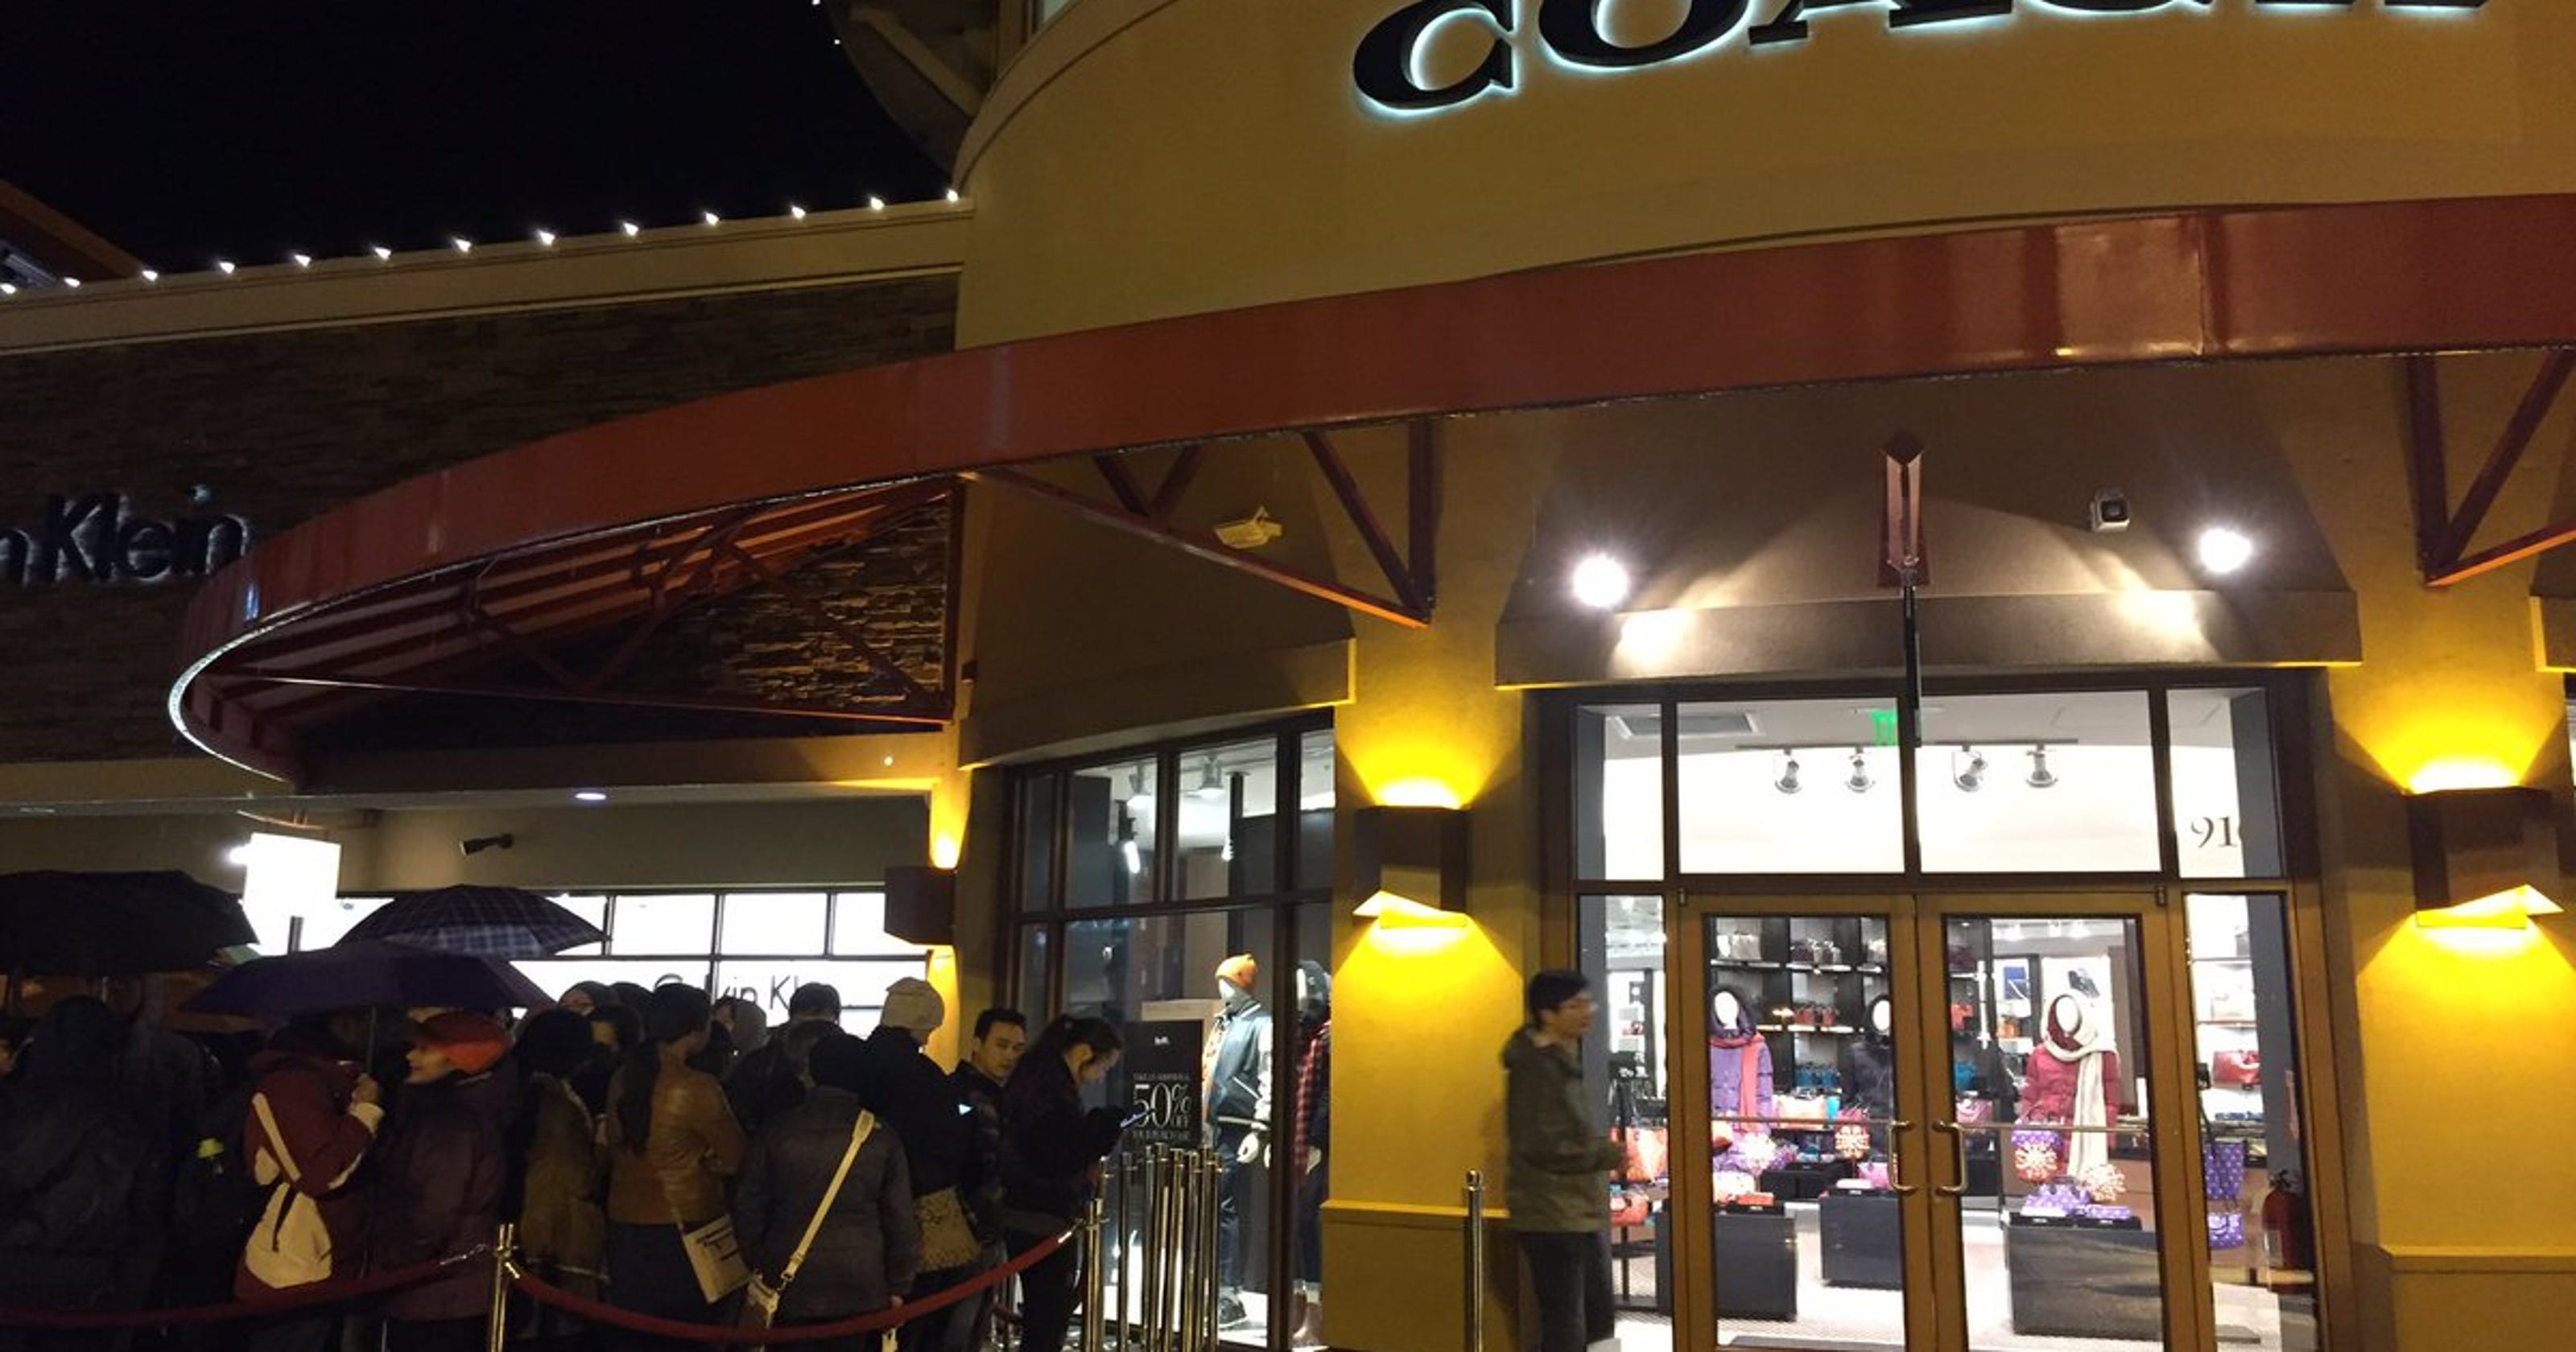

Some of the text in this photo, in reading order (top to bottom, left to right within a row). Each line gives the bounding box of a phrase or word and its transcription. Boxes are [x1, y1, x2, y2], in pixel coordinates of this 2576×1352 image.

[50, 484, 249, 583] Klein
[2190, 815, 2245, 849] 91
[1133, 1082, 1191, 1128] 50%
